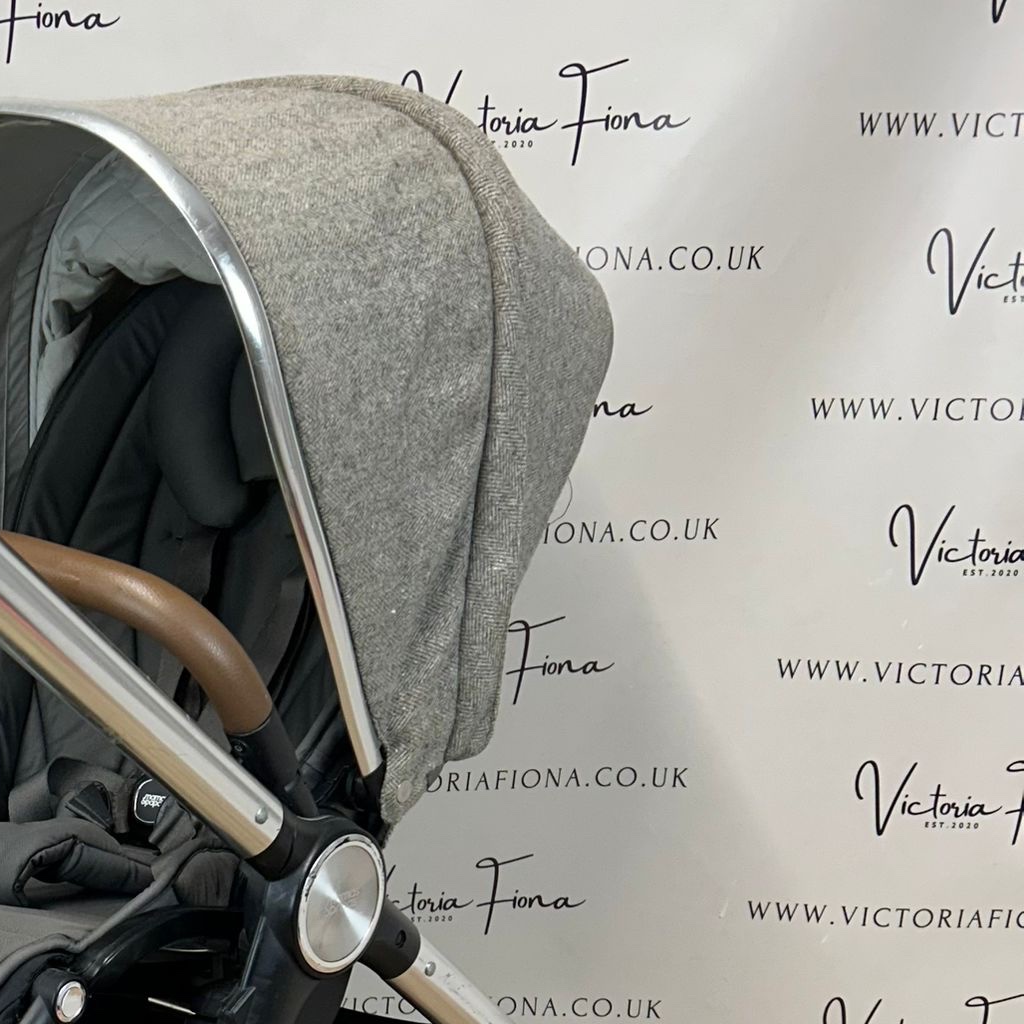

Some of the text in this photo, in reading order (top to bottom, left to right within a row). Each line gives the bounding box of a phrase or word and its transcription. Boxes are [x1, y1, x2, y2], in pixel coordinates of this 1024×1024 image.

[559, 59, 691, 166] Fiona
[506, 616, 615, 705] Fiona
[855, 760, 1003, 836] Victoria
[924, 821, 980, 829] EST.2020
[476, 854, 586, 935] Fiona
